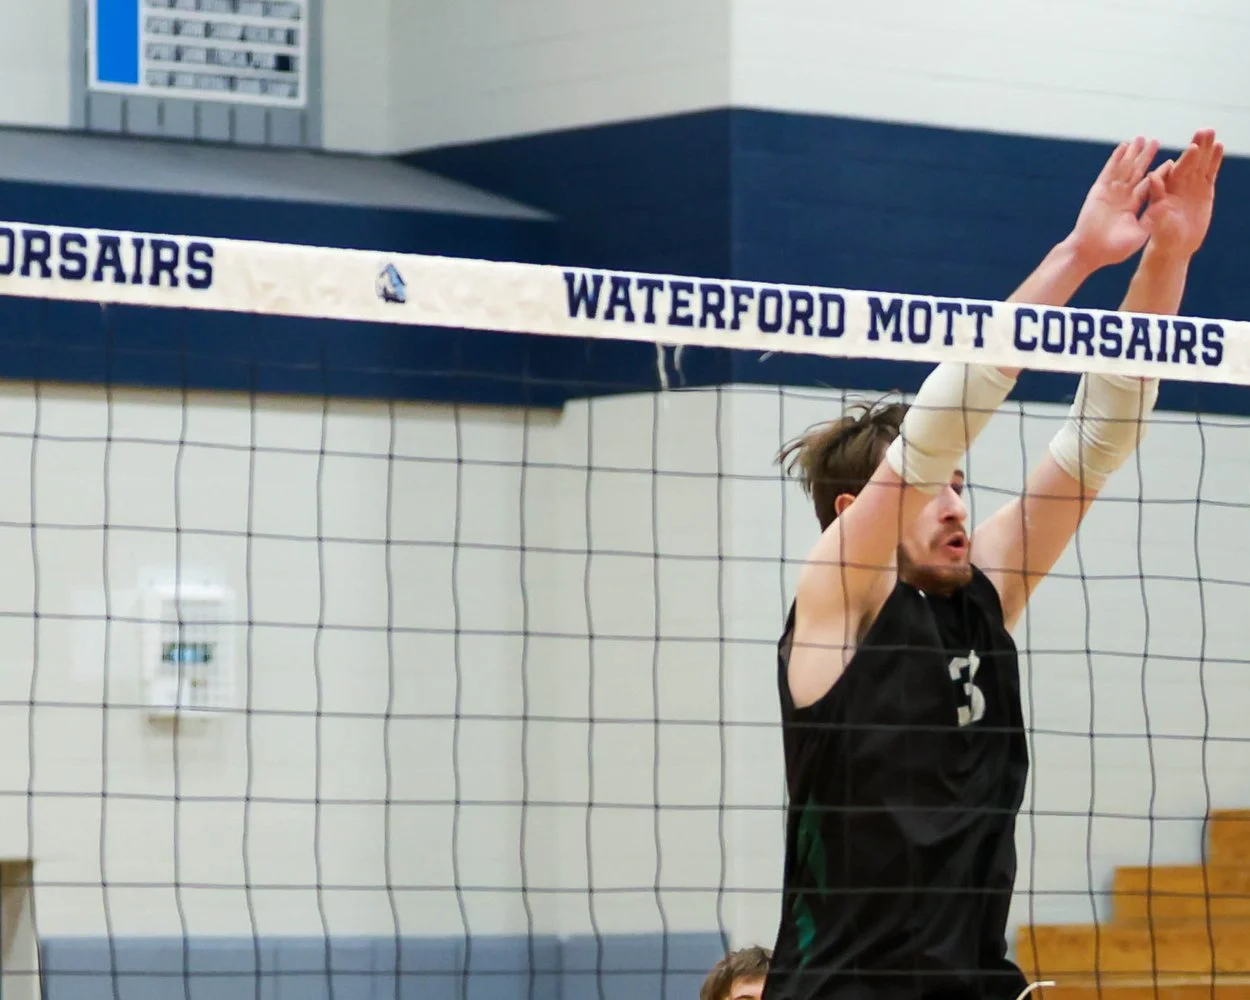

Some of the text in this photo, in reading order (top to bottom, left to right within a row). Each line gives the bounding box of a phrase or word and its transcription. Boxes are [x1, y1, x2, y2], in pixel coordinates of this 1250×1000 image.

[563, 271, 1225, 366] WATERFORD MOTT CORSAIRS
[948, 649, 986, 728] 3
